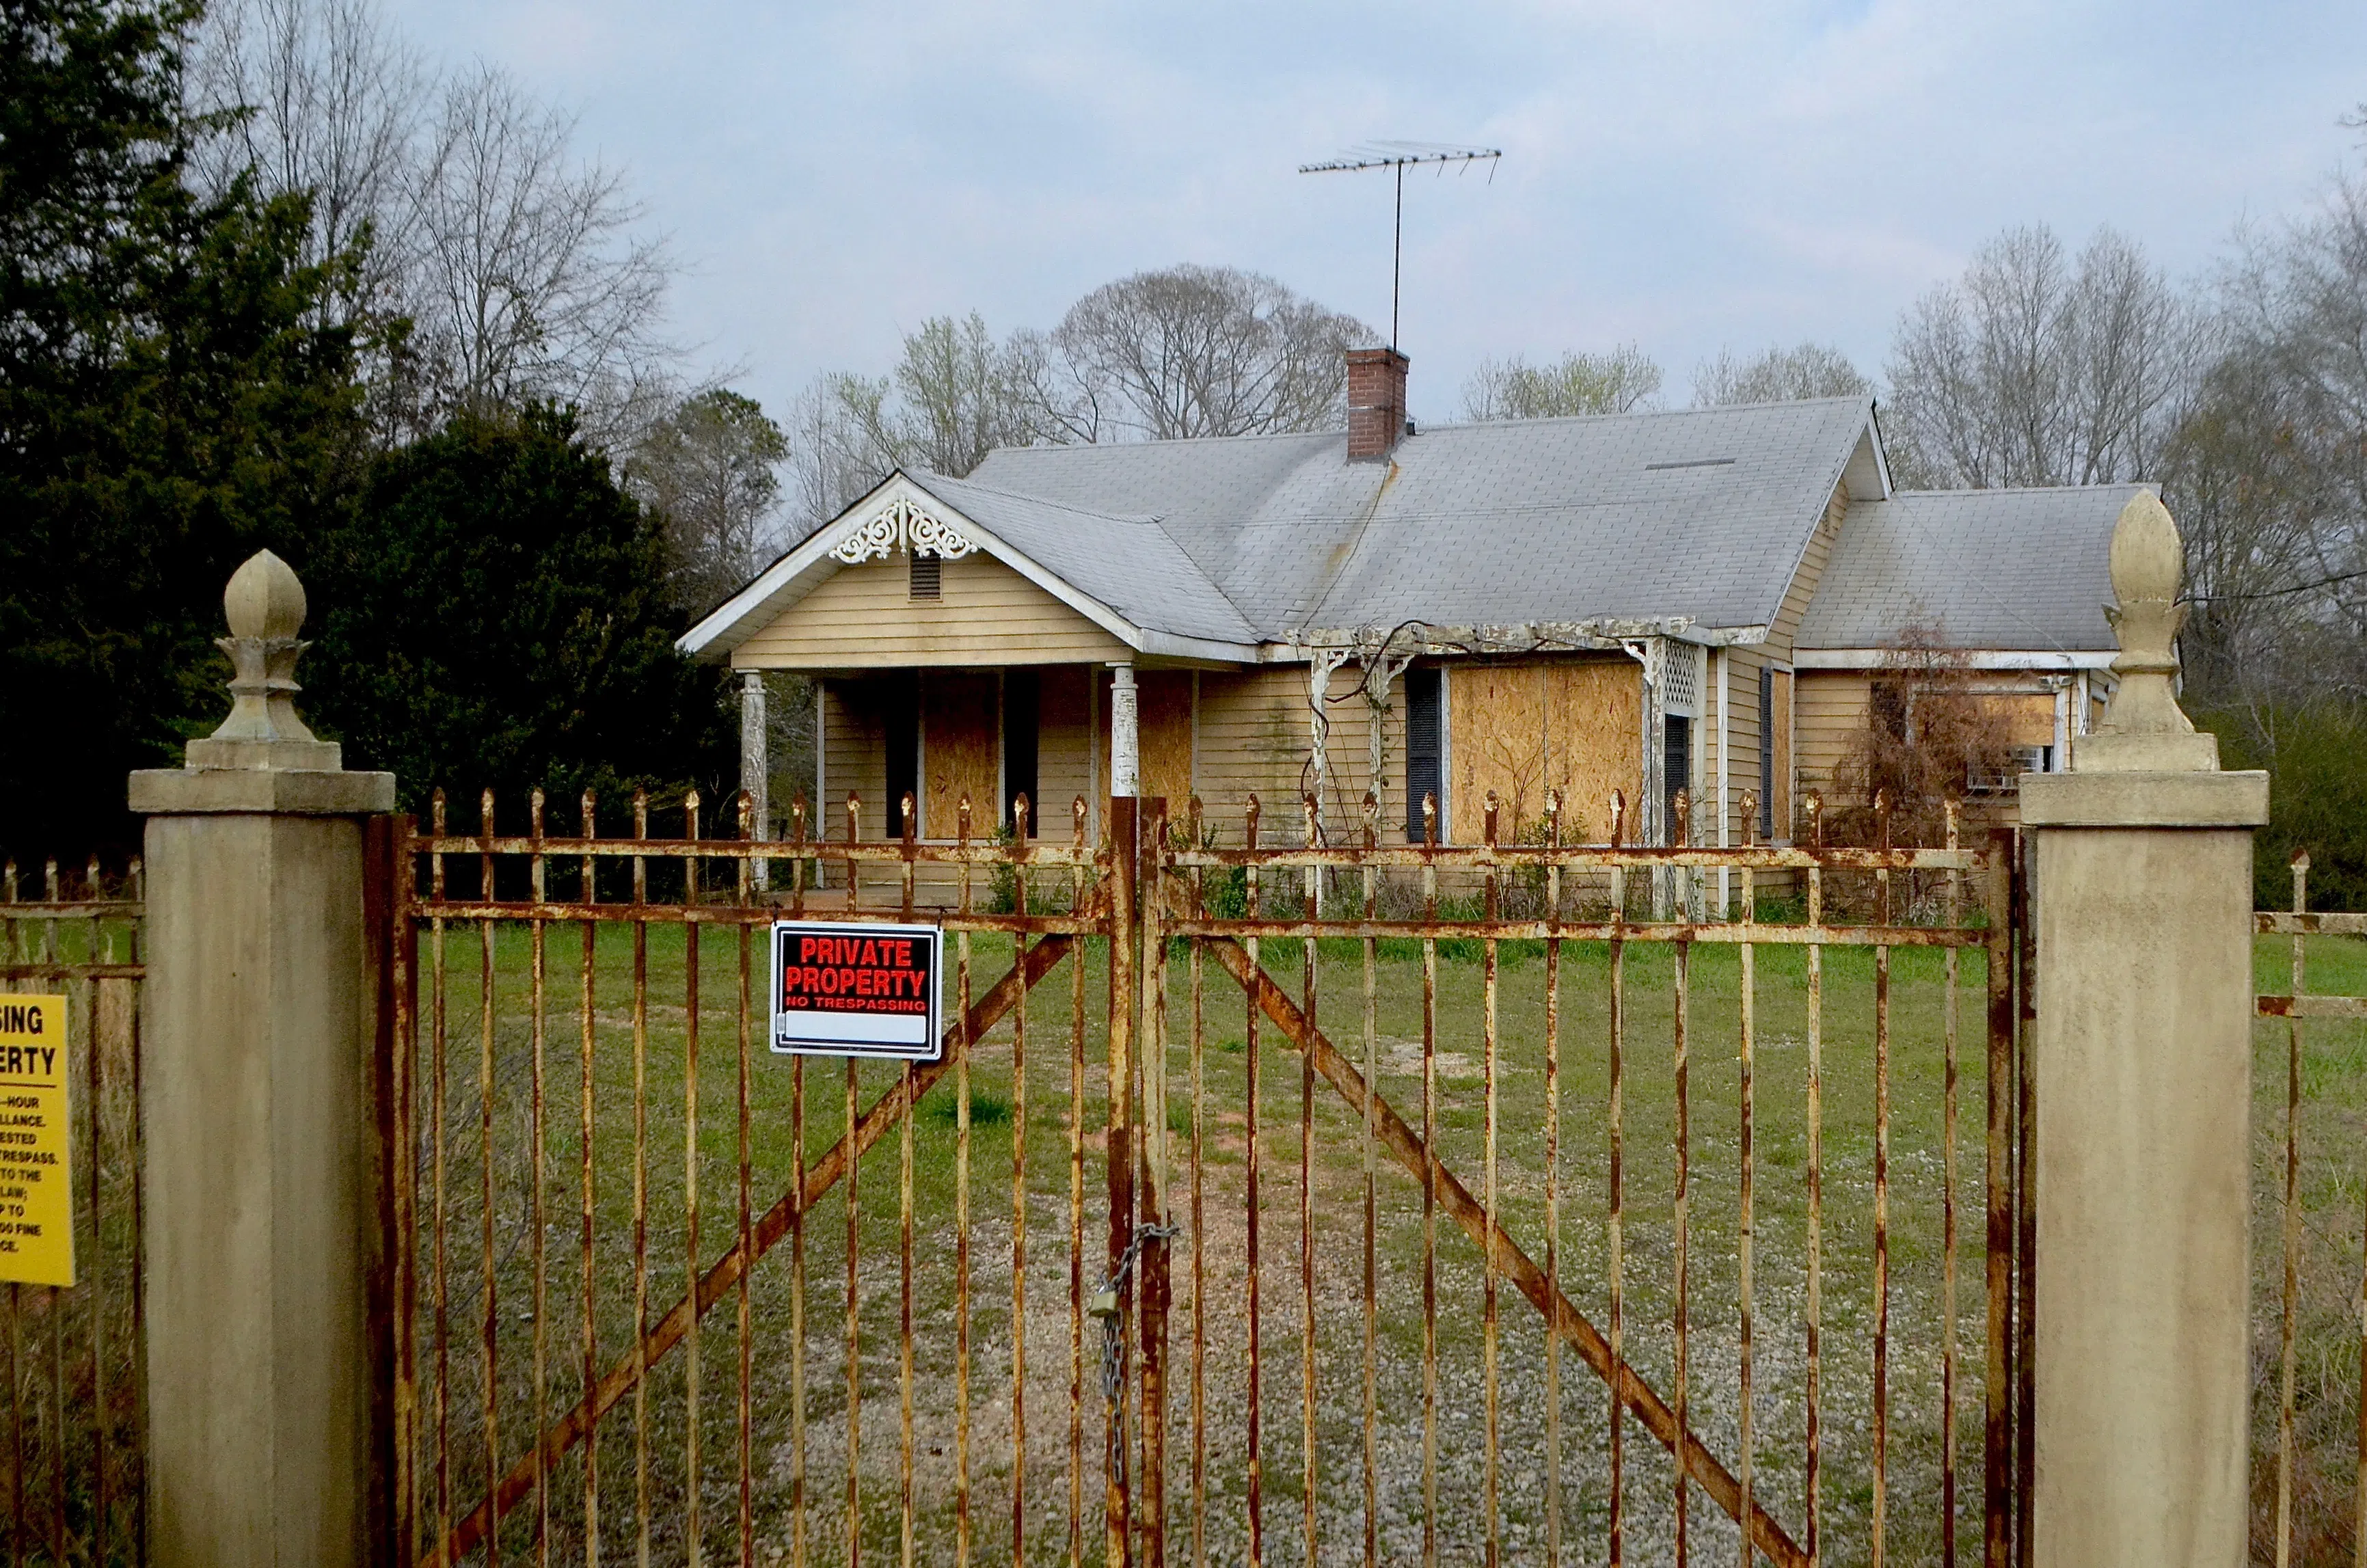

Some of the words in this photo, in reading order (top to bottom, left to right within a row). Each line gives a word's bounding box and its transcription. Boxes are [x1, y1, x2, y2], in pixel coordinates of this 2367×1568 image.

[800, 938, 912, 967] PRIVATE
[786, 967, 925, 997] PROPERTY
[785, 996, 809, 1008] NO
[813, 996, 927, 1012] TRESPASSING
[0, 1045, 56, 1075] ERTY
[18, 1168, 42, 1182] THE
[8, 1204, 25, 1217] TO
[16, 1222, 42, 1236] FINE
